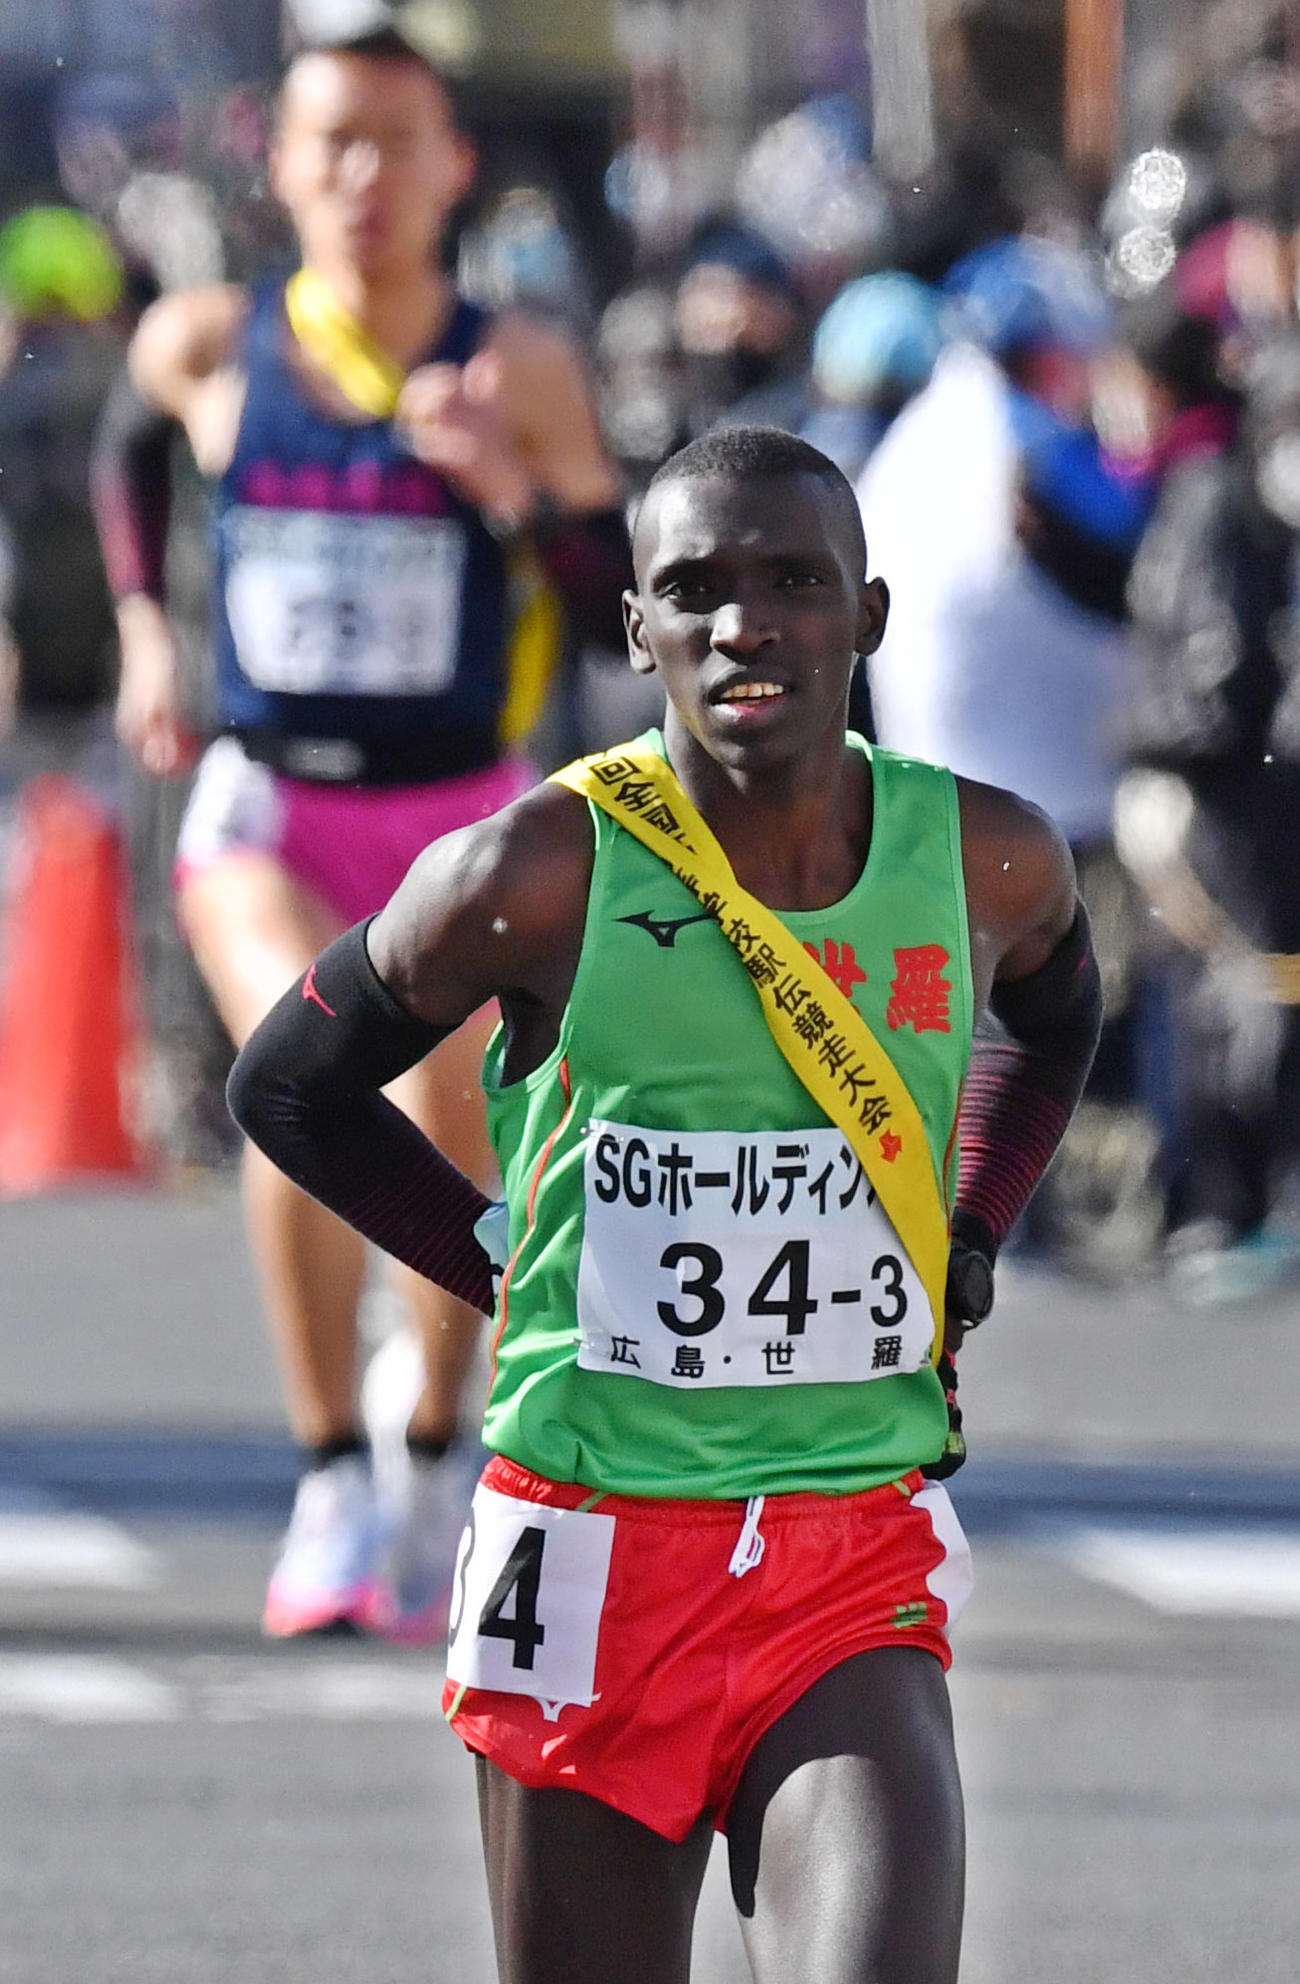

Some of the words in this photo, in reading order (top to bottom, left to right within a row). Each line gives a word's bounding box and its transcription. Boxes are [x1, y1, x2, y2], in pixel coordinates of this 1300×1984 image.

[594, 1134, 878, 1216] SGホールディン
[656, 1239, 908, 1337] 34-3
[610, 1334, 903, 1379] 広島・世羅
